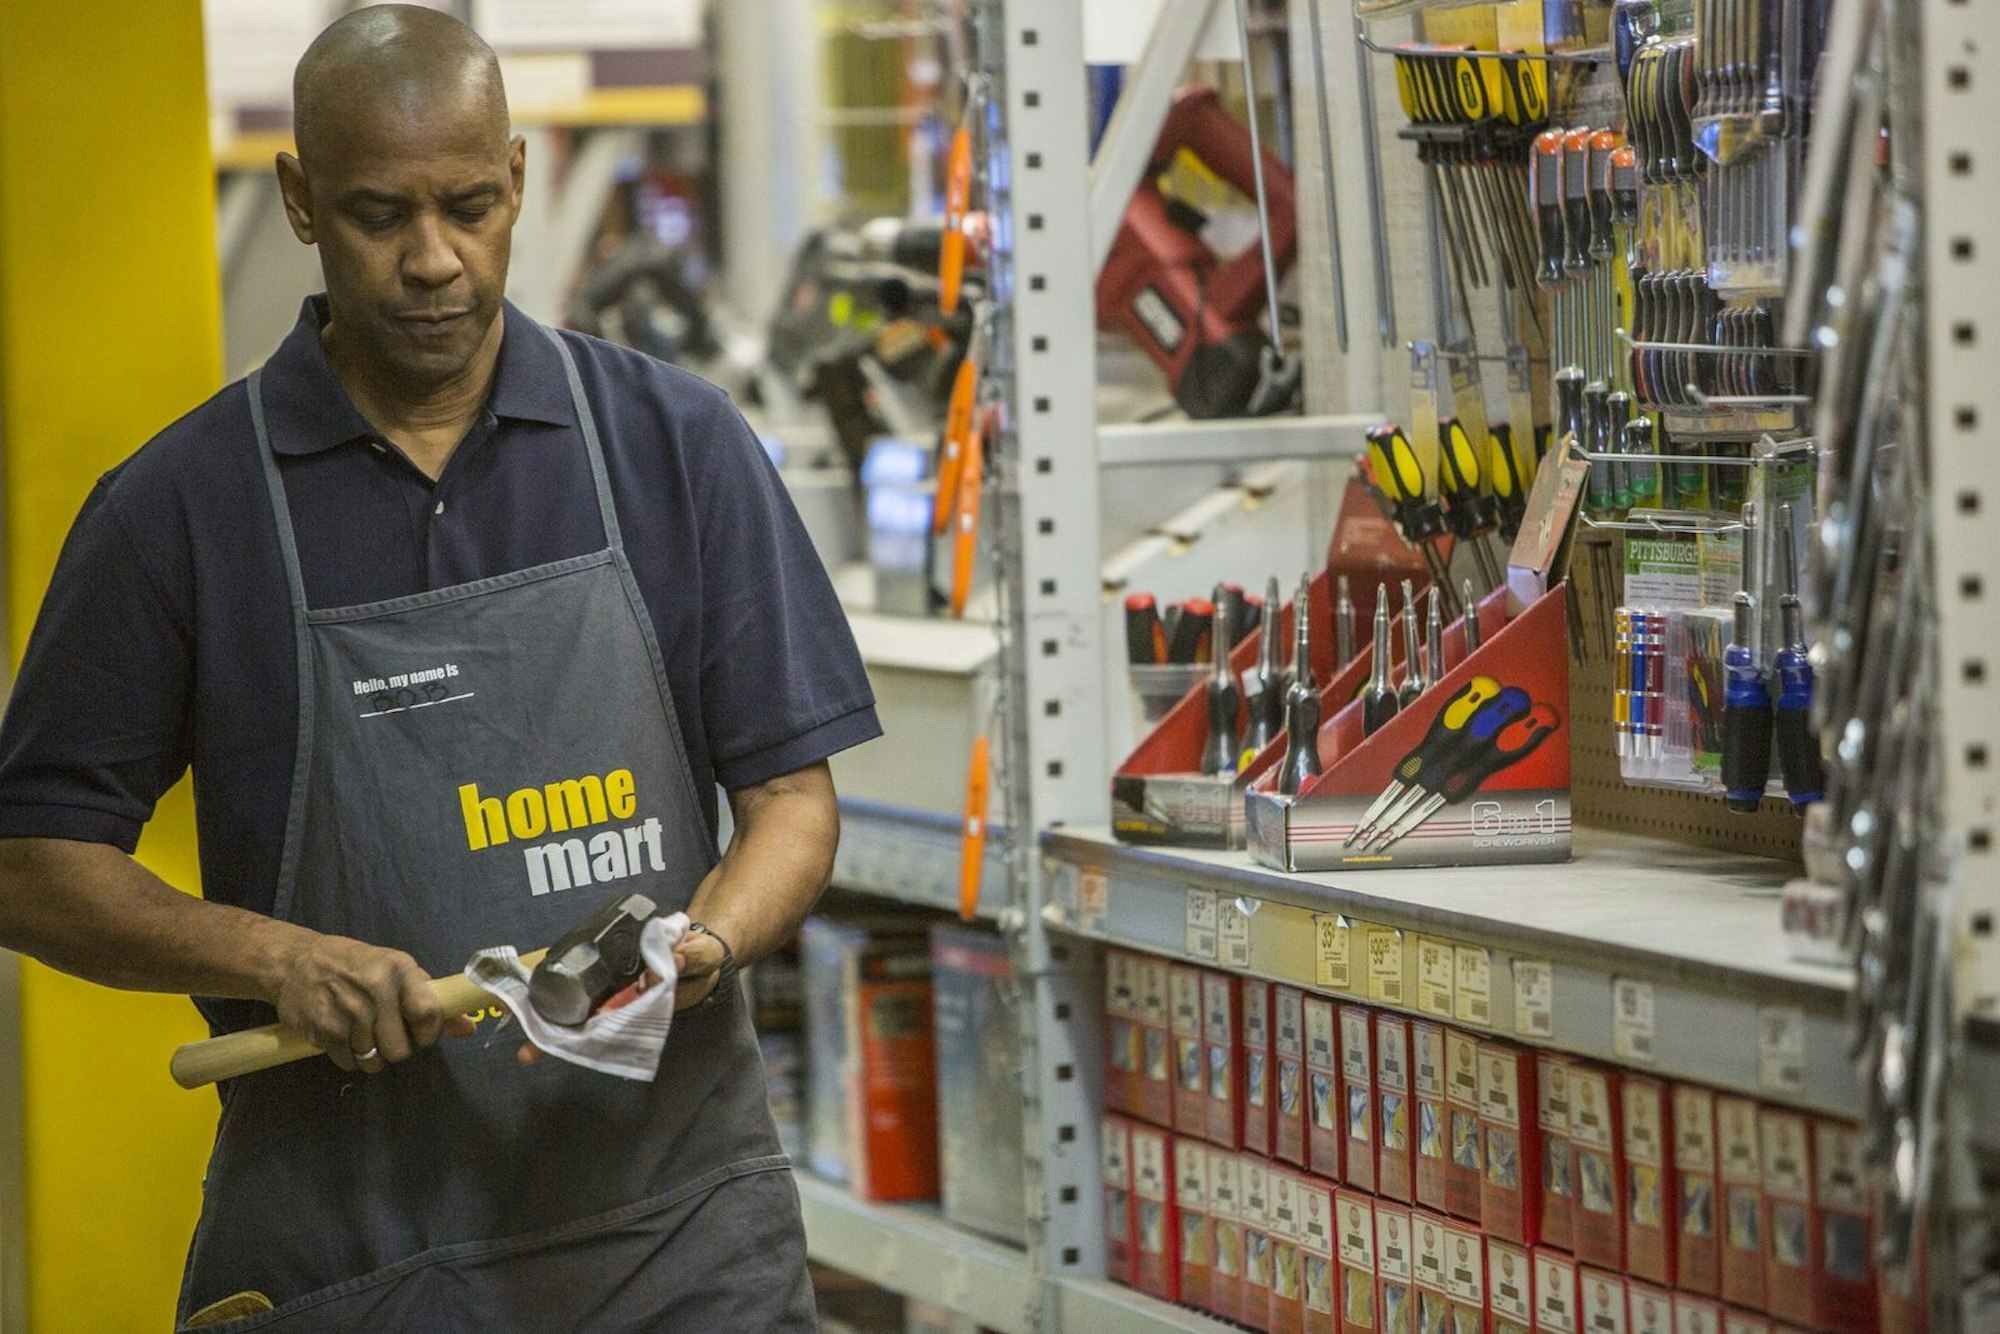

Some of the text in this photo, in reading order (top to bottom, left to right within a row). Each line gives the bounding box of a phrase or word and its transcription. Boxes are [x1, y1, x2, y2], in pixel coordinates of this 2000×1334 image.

[353, 663, 460, 695] Hello, my name is
[457, 768, 637, 852] home
[1471, 799, 1555, 836] 6 in 1
[523, 817, 666, 896] mart
[1472, 837, 1556, 848] SCREWDRIVER
